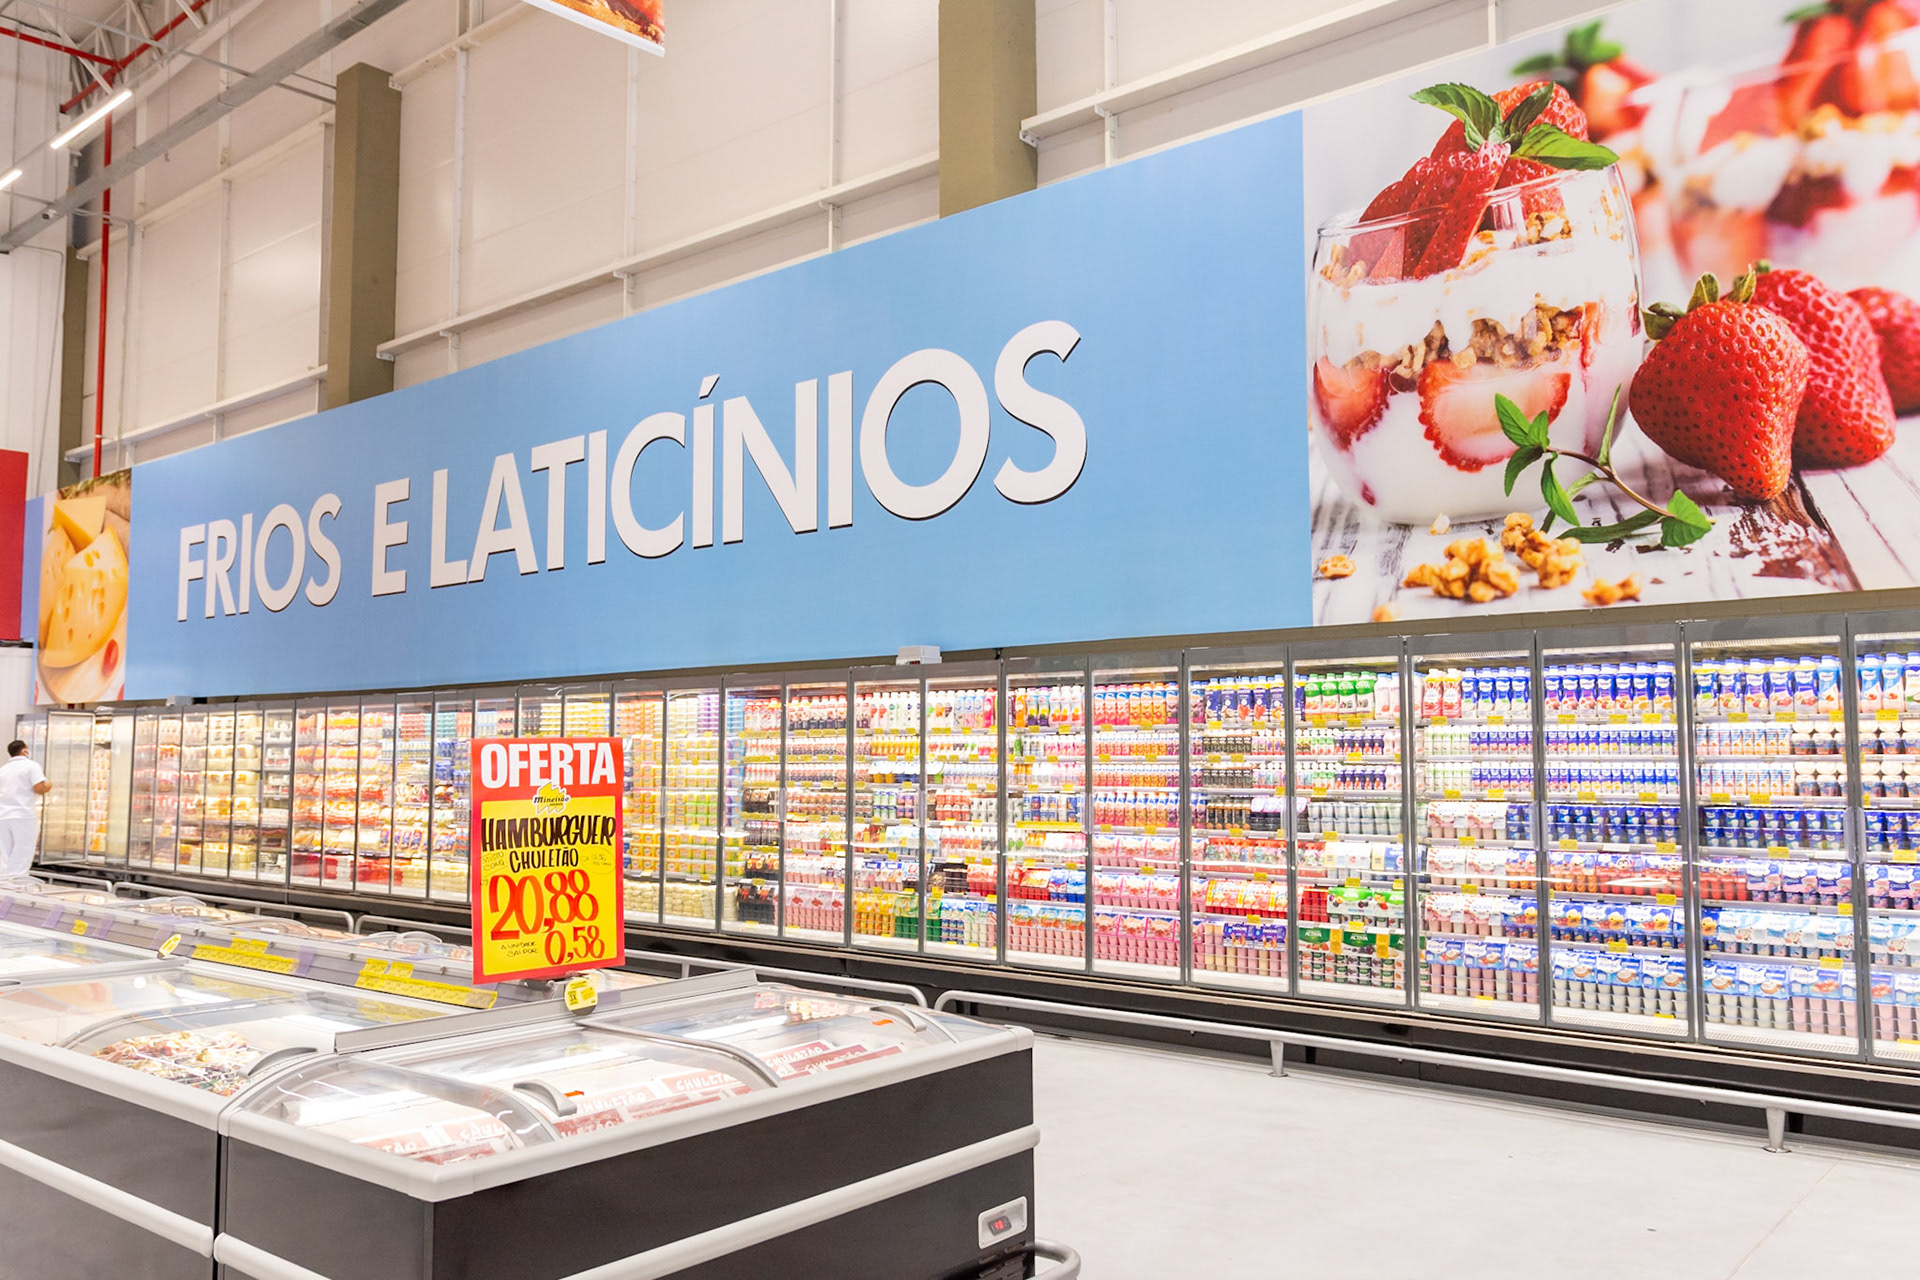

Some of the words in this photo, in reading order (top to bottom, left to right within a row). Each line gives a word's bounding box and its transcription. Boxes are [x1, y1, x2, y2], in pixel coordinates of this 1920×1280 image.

[177, 493, 343, 622] FRIOS
[370, 477, 411, 597] E
[429, 320, 1088, 590] LATICÍNIOS
[481, 742, 616, 788] OFERTA
[481, 815, 616, 852] HAMBURGUER
[509, 846, 579, 873] CHULETÃO
[489, 869, 599, 941] 20,88
[545, 925, 605, 965] 0,58
